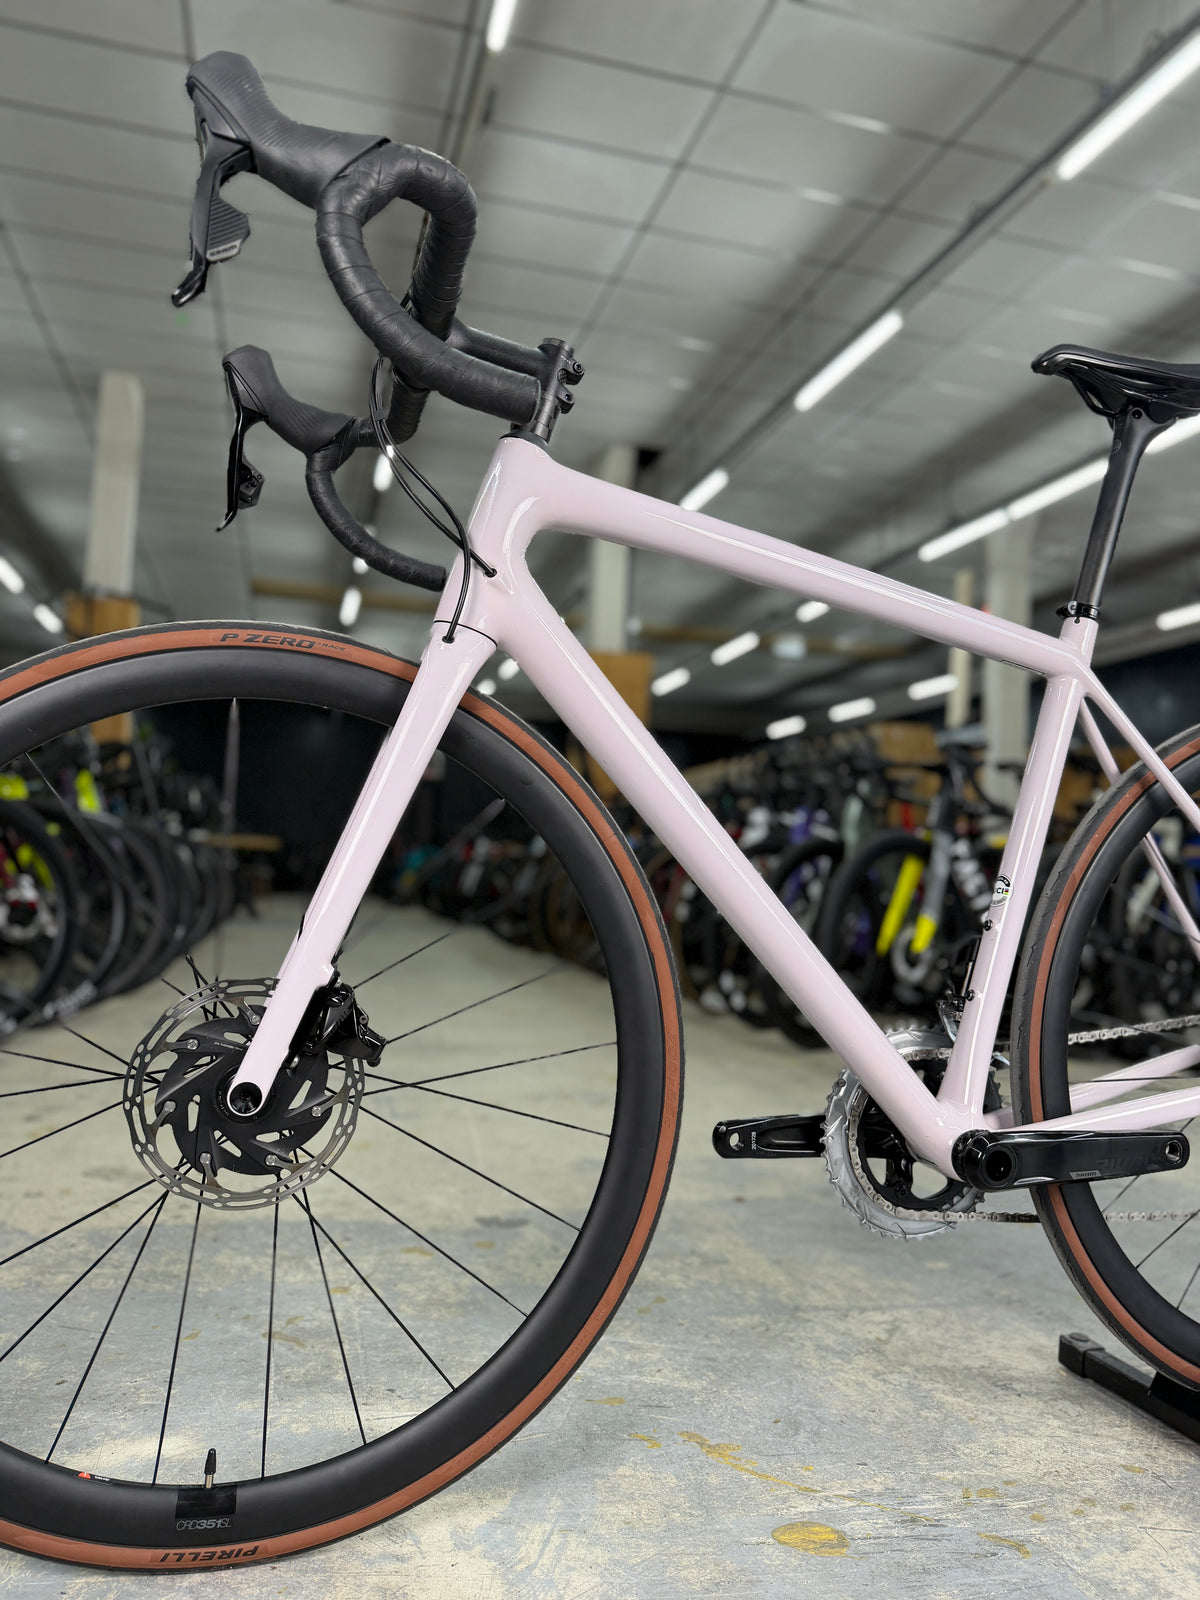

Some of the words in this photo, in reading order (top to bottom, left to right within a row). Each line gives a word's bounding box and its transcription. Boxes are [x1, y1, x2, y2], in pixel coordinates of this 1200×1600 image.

[220, 633, 239, 642] P
[243, 633, 316, 649] ZERO
[160, 1545, 259, 1562] PIRELLI
